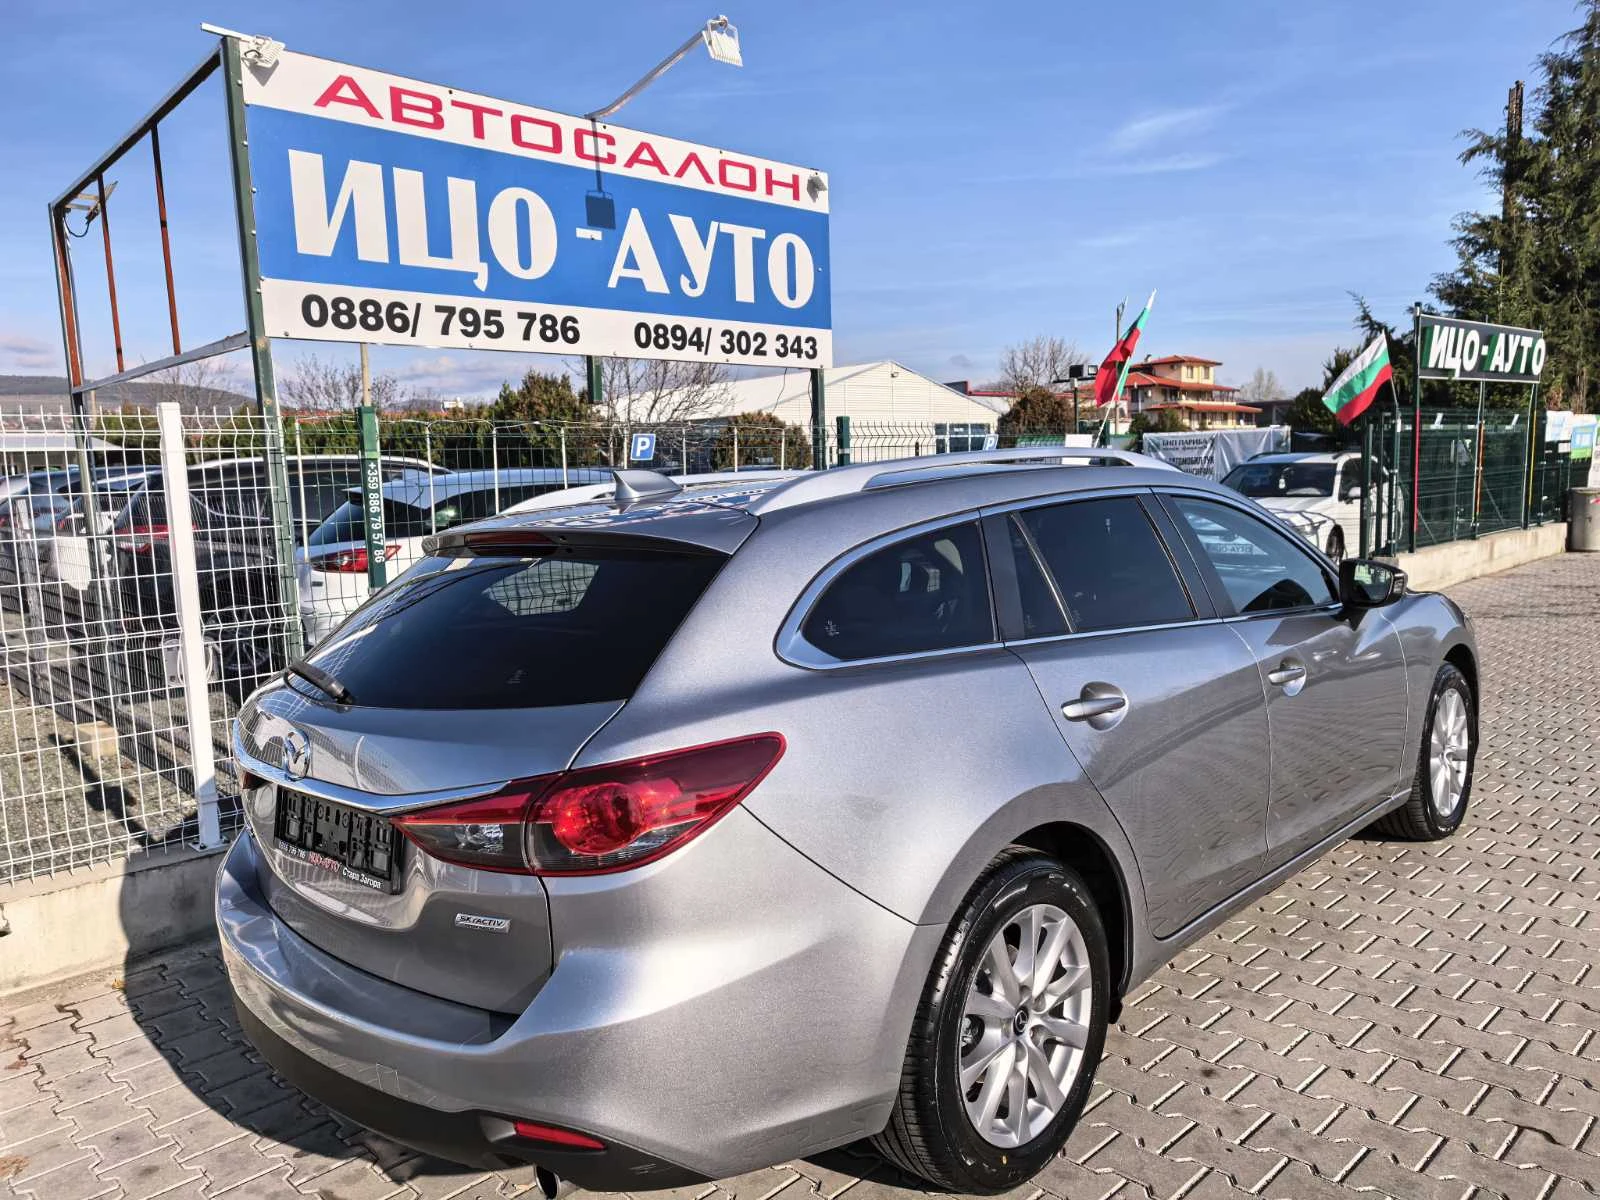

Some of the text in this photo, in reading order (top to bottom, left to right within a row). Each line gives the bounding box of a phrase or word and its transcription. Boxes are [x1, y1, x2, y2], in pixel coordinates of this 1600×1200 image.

[313, 75, 800, 201] АВТОСАЛОН
[301, 294, 818, 360] 0886/ 795 786 0894/ 302 343
[636, 437, 651, 456] P
[367, 462, 385, 563] +359 886 79 57 86
[342, 867, 360, 881] Стара
[360, 873, 382, 889] Загора
